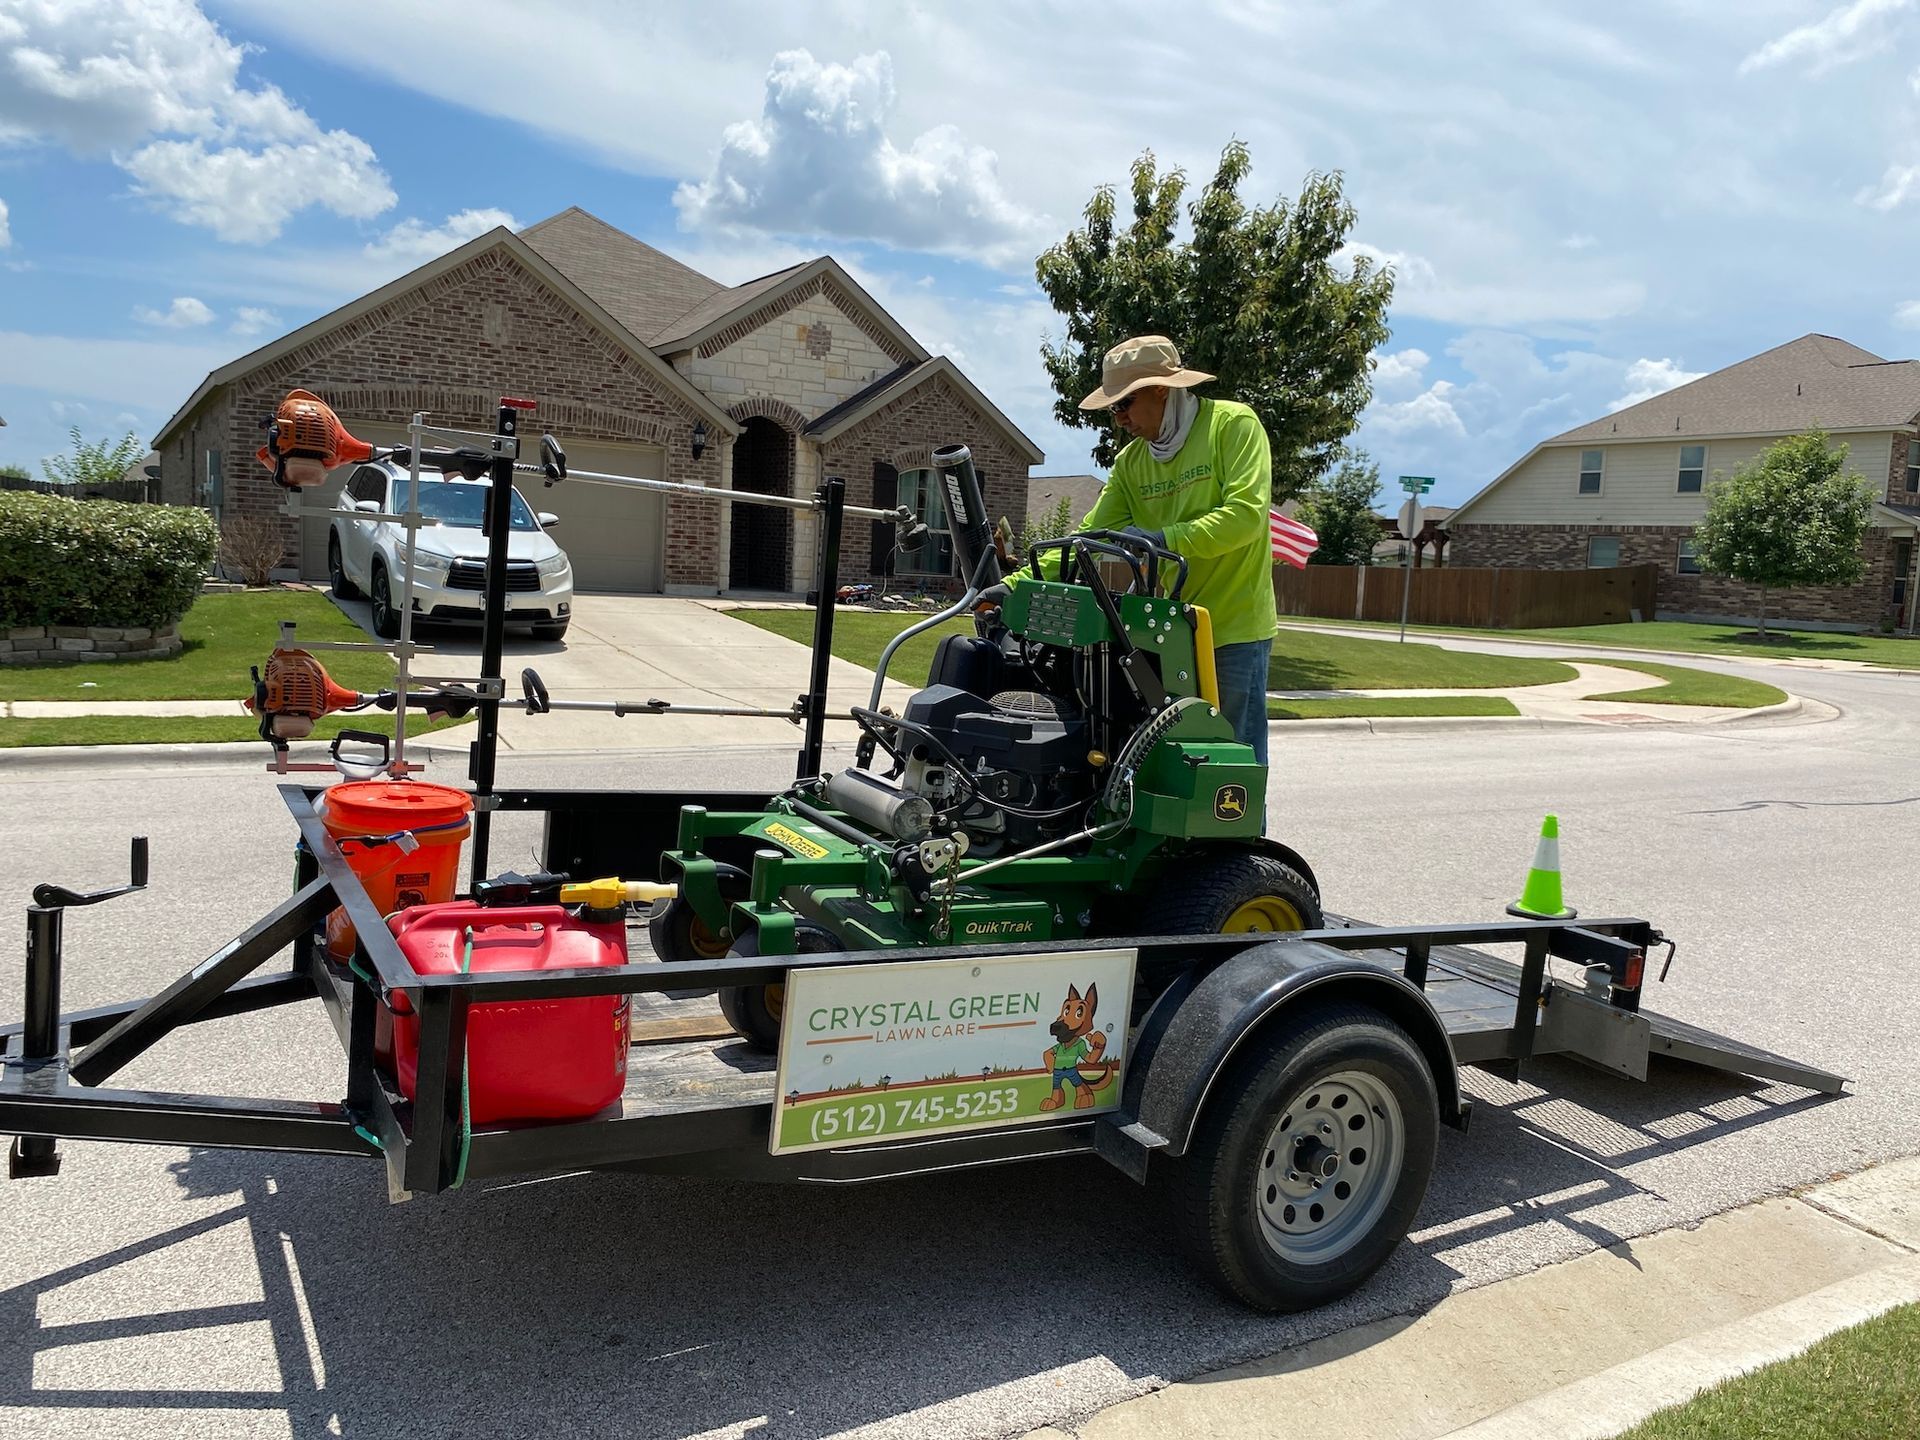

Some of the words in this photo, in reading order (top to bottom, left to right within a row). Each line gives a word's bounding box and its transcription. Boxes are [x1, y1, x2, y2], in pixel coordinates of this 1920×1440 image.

[945, 473, 968, 522] ECHO
[808, 1000, 940, 1032] CRYSTAL
[949, 992, 1040, 1019] GREEN
[876, 1027, 926, 1043] LAWN
[931, 1022, 976, 1038] CARE
[811, 1103, 886, 1142] (512)
[895, 1087, 1019, 1126] 745-5253
